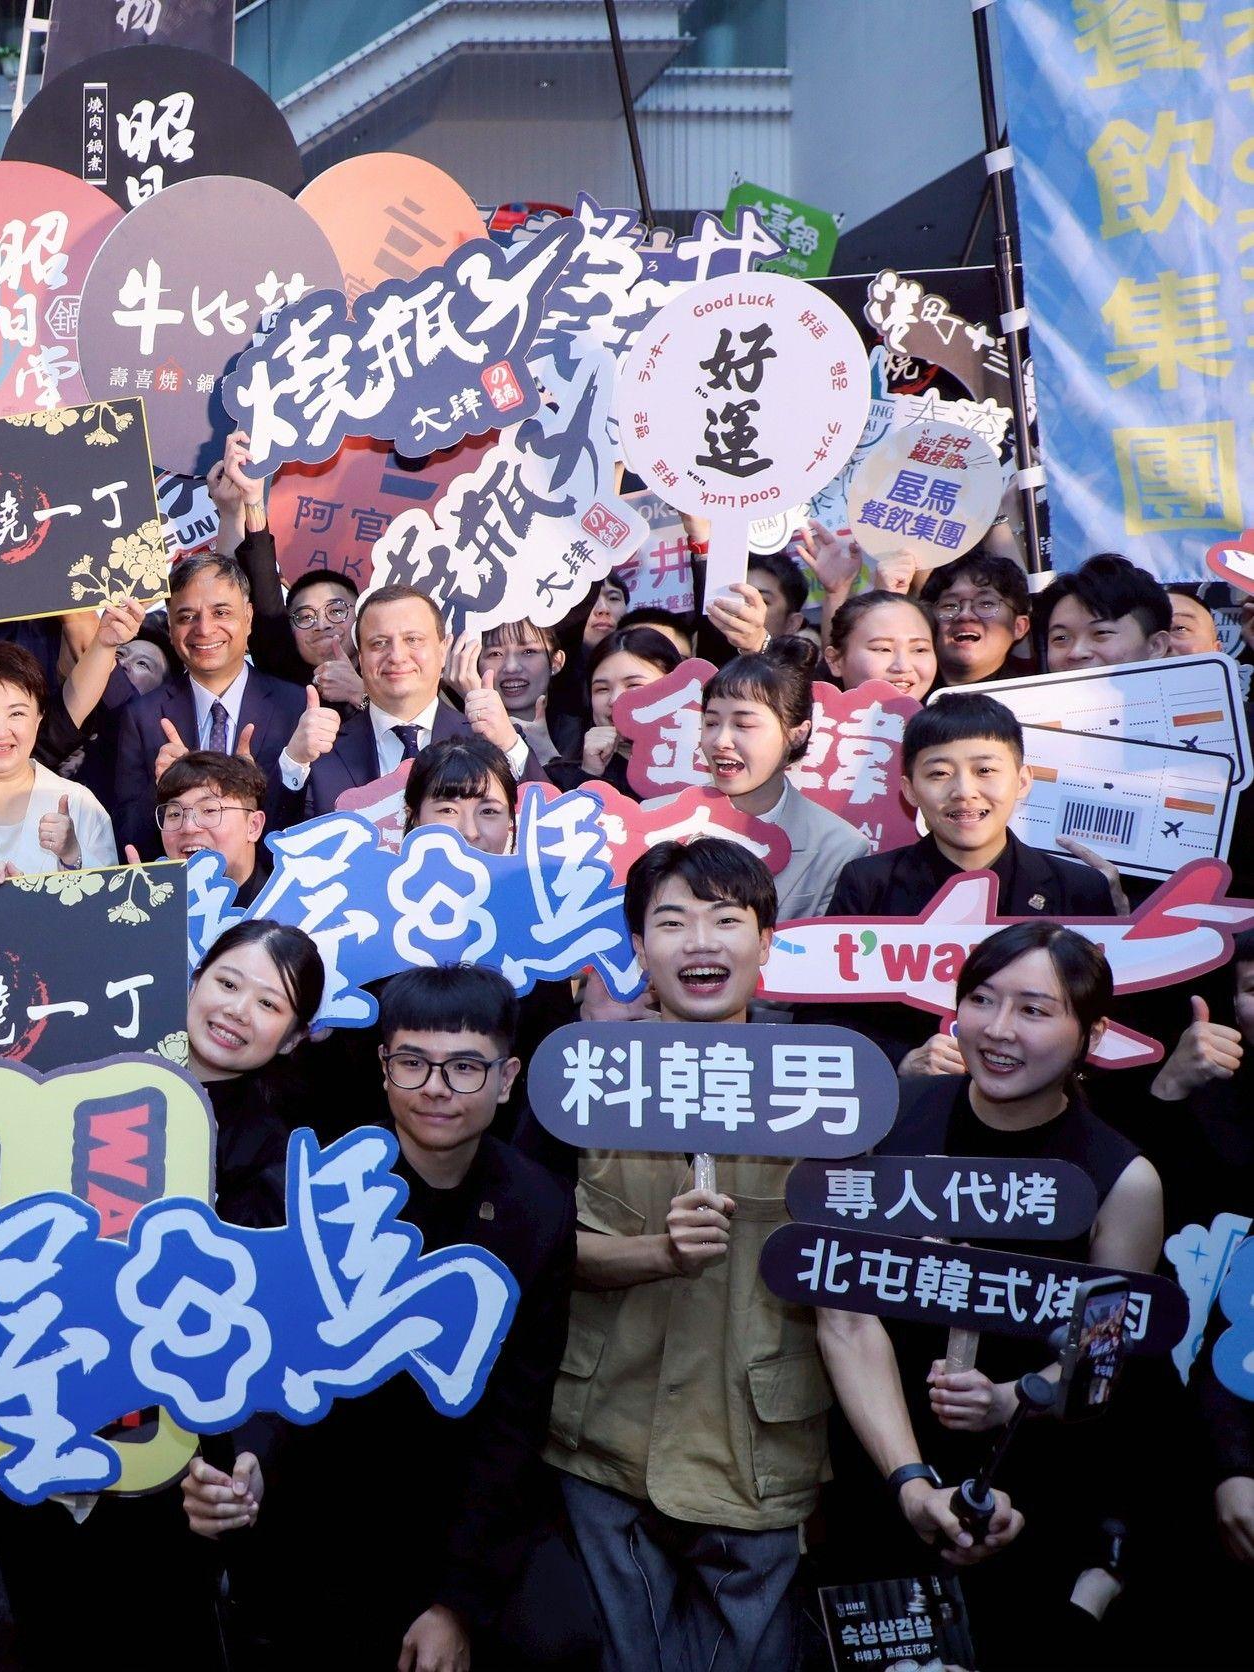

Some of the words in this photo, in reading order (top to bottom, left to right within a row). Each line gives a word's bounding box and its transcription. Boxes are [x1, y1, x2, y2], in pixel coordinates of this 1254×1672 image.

[693, 294, 733, 317] Good
[738, 293, 775, 308] Luck
[696, 323, 778, 477] 好運
[700, 491, 735, 507] Luck
[741, 486, 780, 507] Good
[886, 470, 962, 515] 屋馬
[857, 499, 968, 549] 餐飲集團
[561, 1039, 860, 1135] 料韓男
[825, 1168, 1058, 1225] 專人代烤
